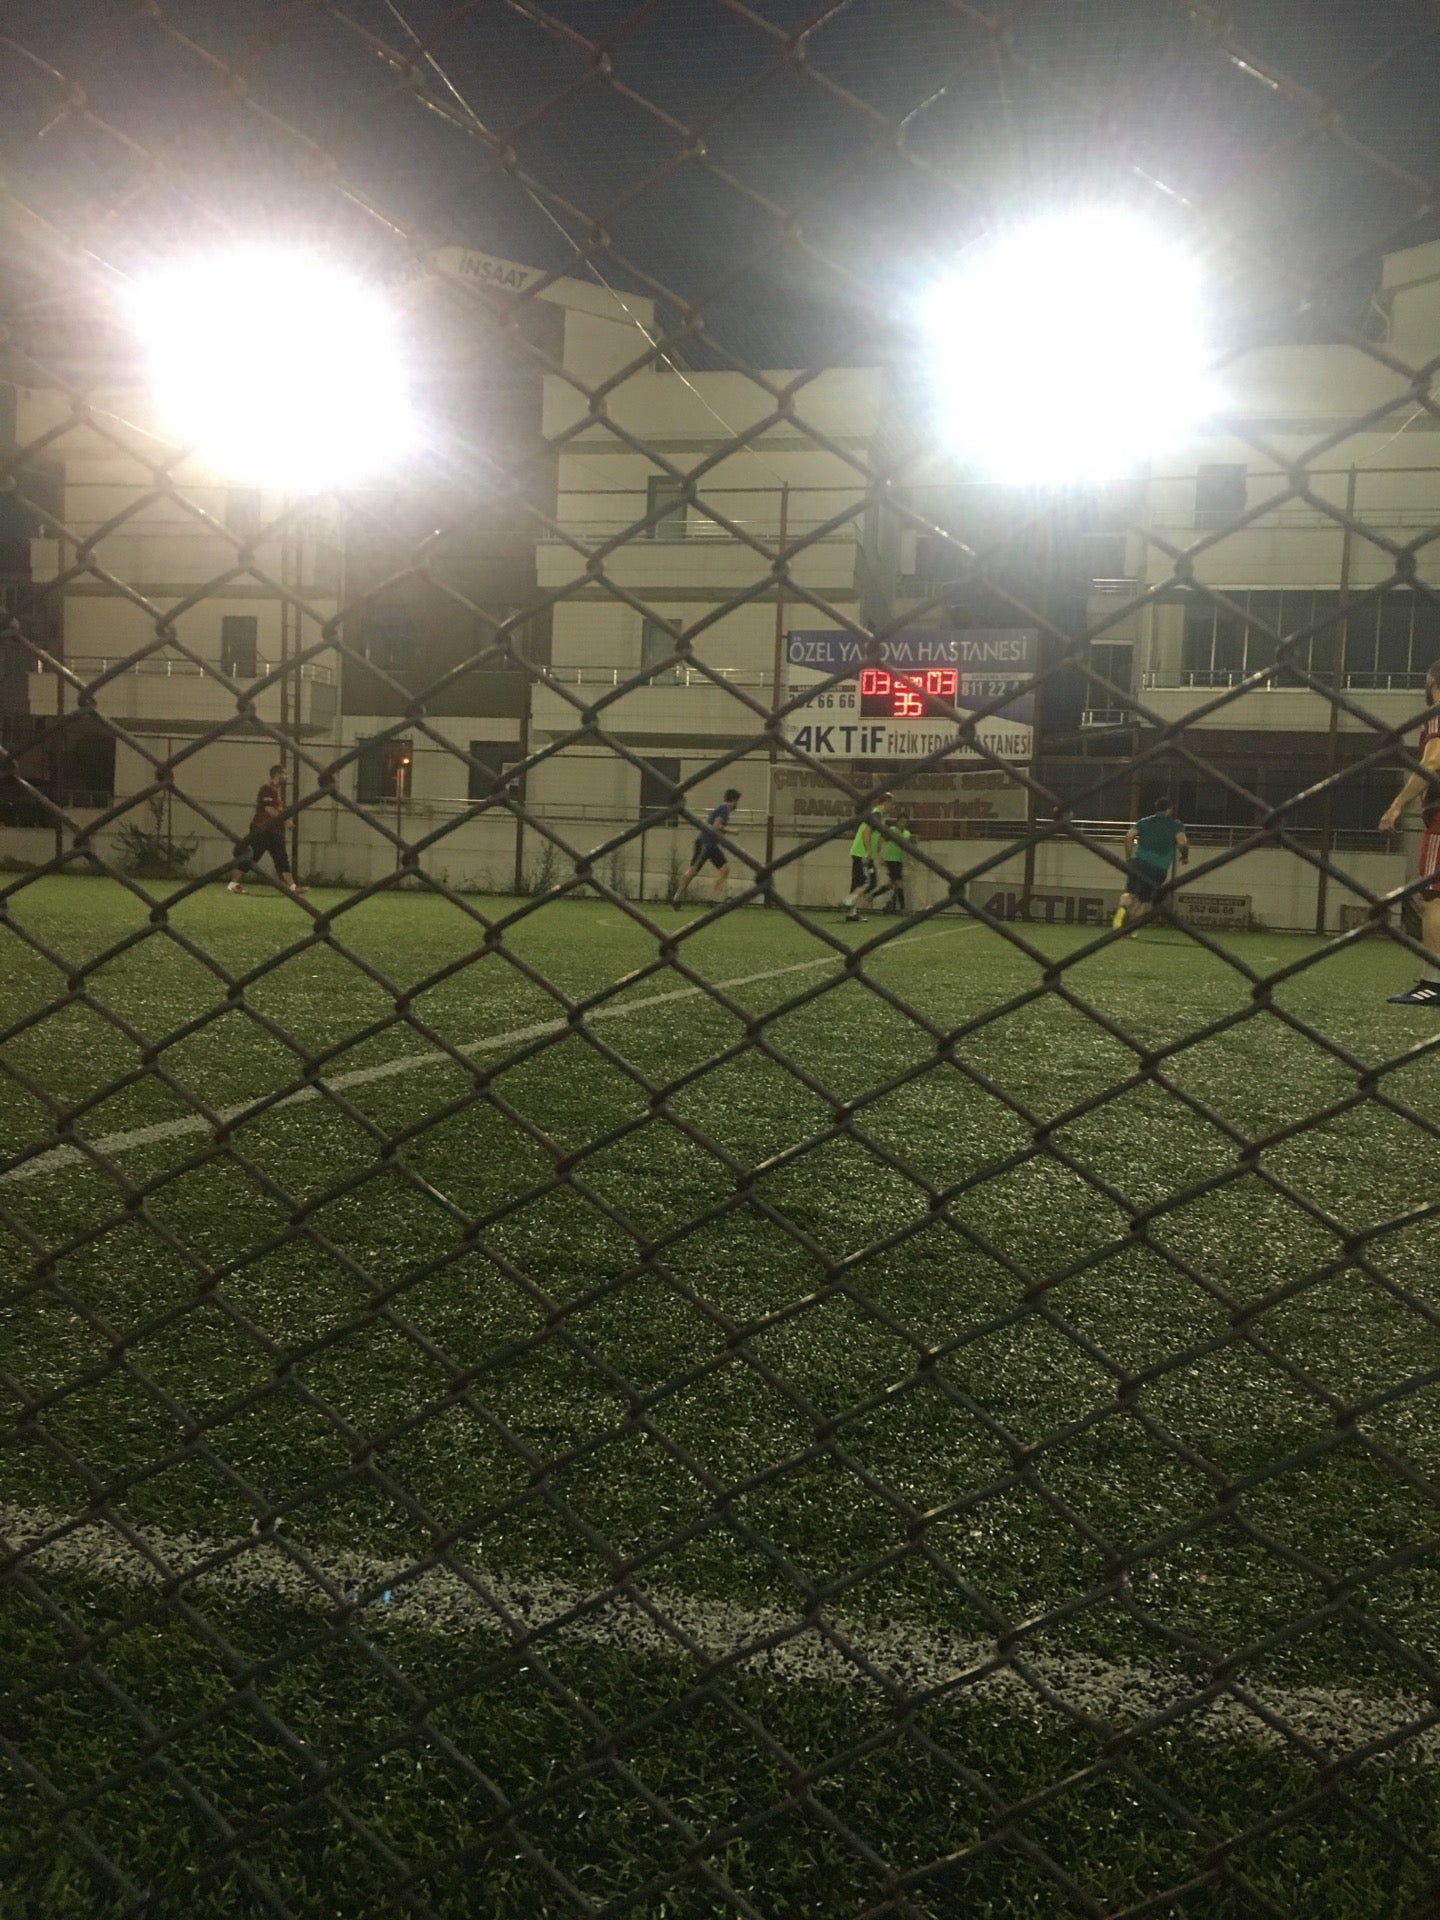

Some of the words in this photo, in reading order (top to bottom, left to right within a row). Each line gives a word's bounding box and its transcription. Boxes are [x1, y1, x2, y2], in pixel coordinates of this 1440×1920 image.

[789, 637, 835, 662] ÖZEL
[839, 641, 913, 662] YAOVA
[918, 636, 1027, 661] HASTANESİ
[862, 670, 891, 694] 03
[926, 670, 957, 694] 03
[818, 694, 834, 708] 66
[839, 694, 856, 708] 66
[893, 692, 923, 716] 35
[888, 730, 919, 753] FİZİK
